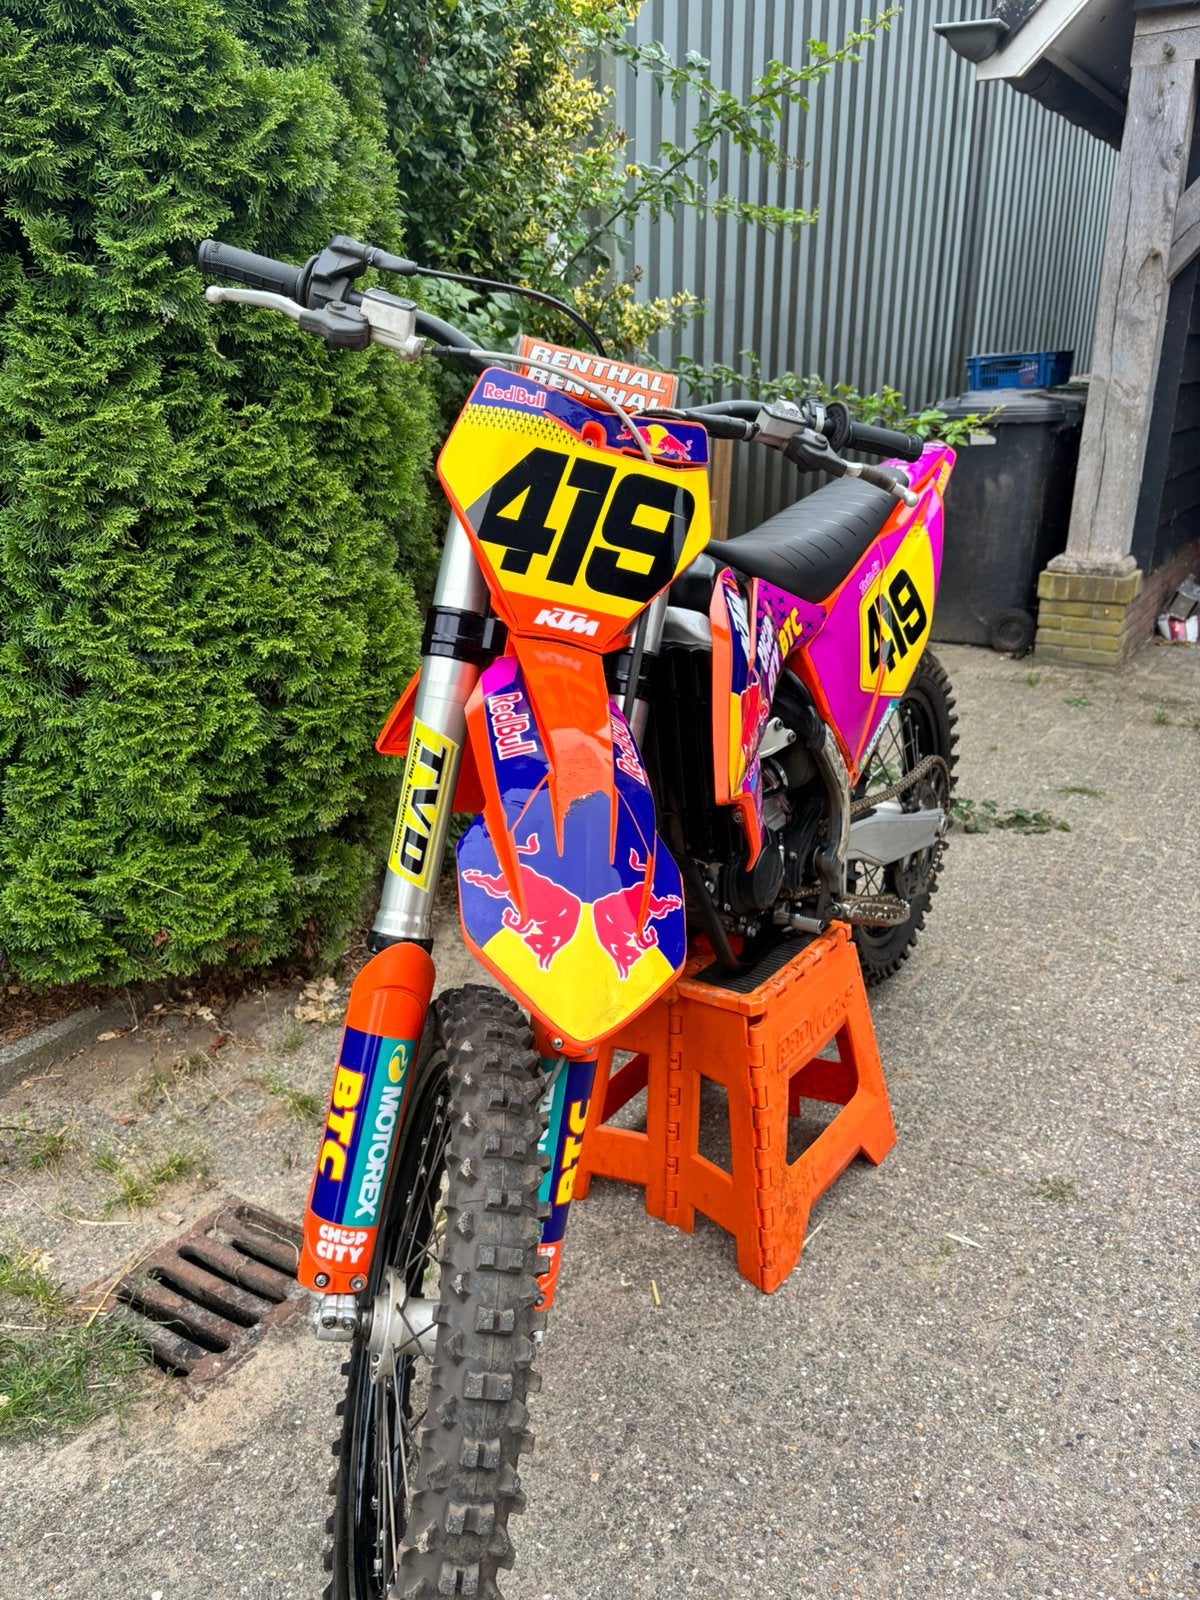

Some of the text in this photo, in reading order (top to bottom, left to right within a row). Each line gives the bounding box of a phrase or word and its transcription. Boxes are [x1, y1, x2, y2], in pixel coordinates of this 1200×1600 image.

[529, 345, 667, 393] RENTHAL
[465, 447, 696, 604] 419
[533, 607, 600, 637] KTM
[867, 569, 927, 675] 419
[394, 737, 421, 854] Racing Suspension
[400, 744, 448, 876] TVD
[319, 1065, 366, 1182] BTC
[355, 1086, 403, 1219] MOTOREX
[316, 1240, 365, 1264] CITY
